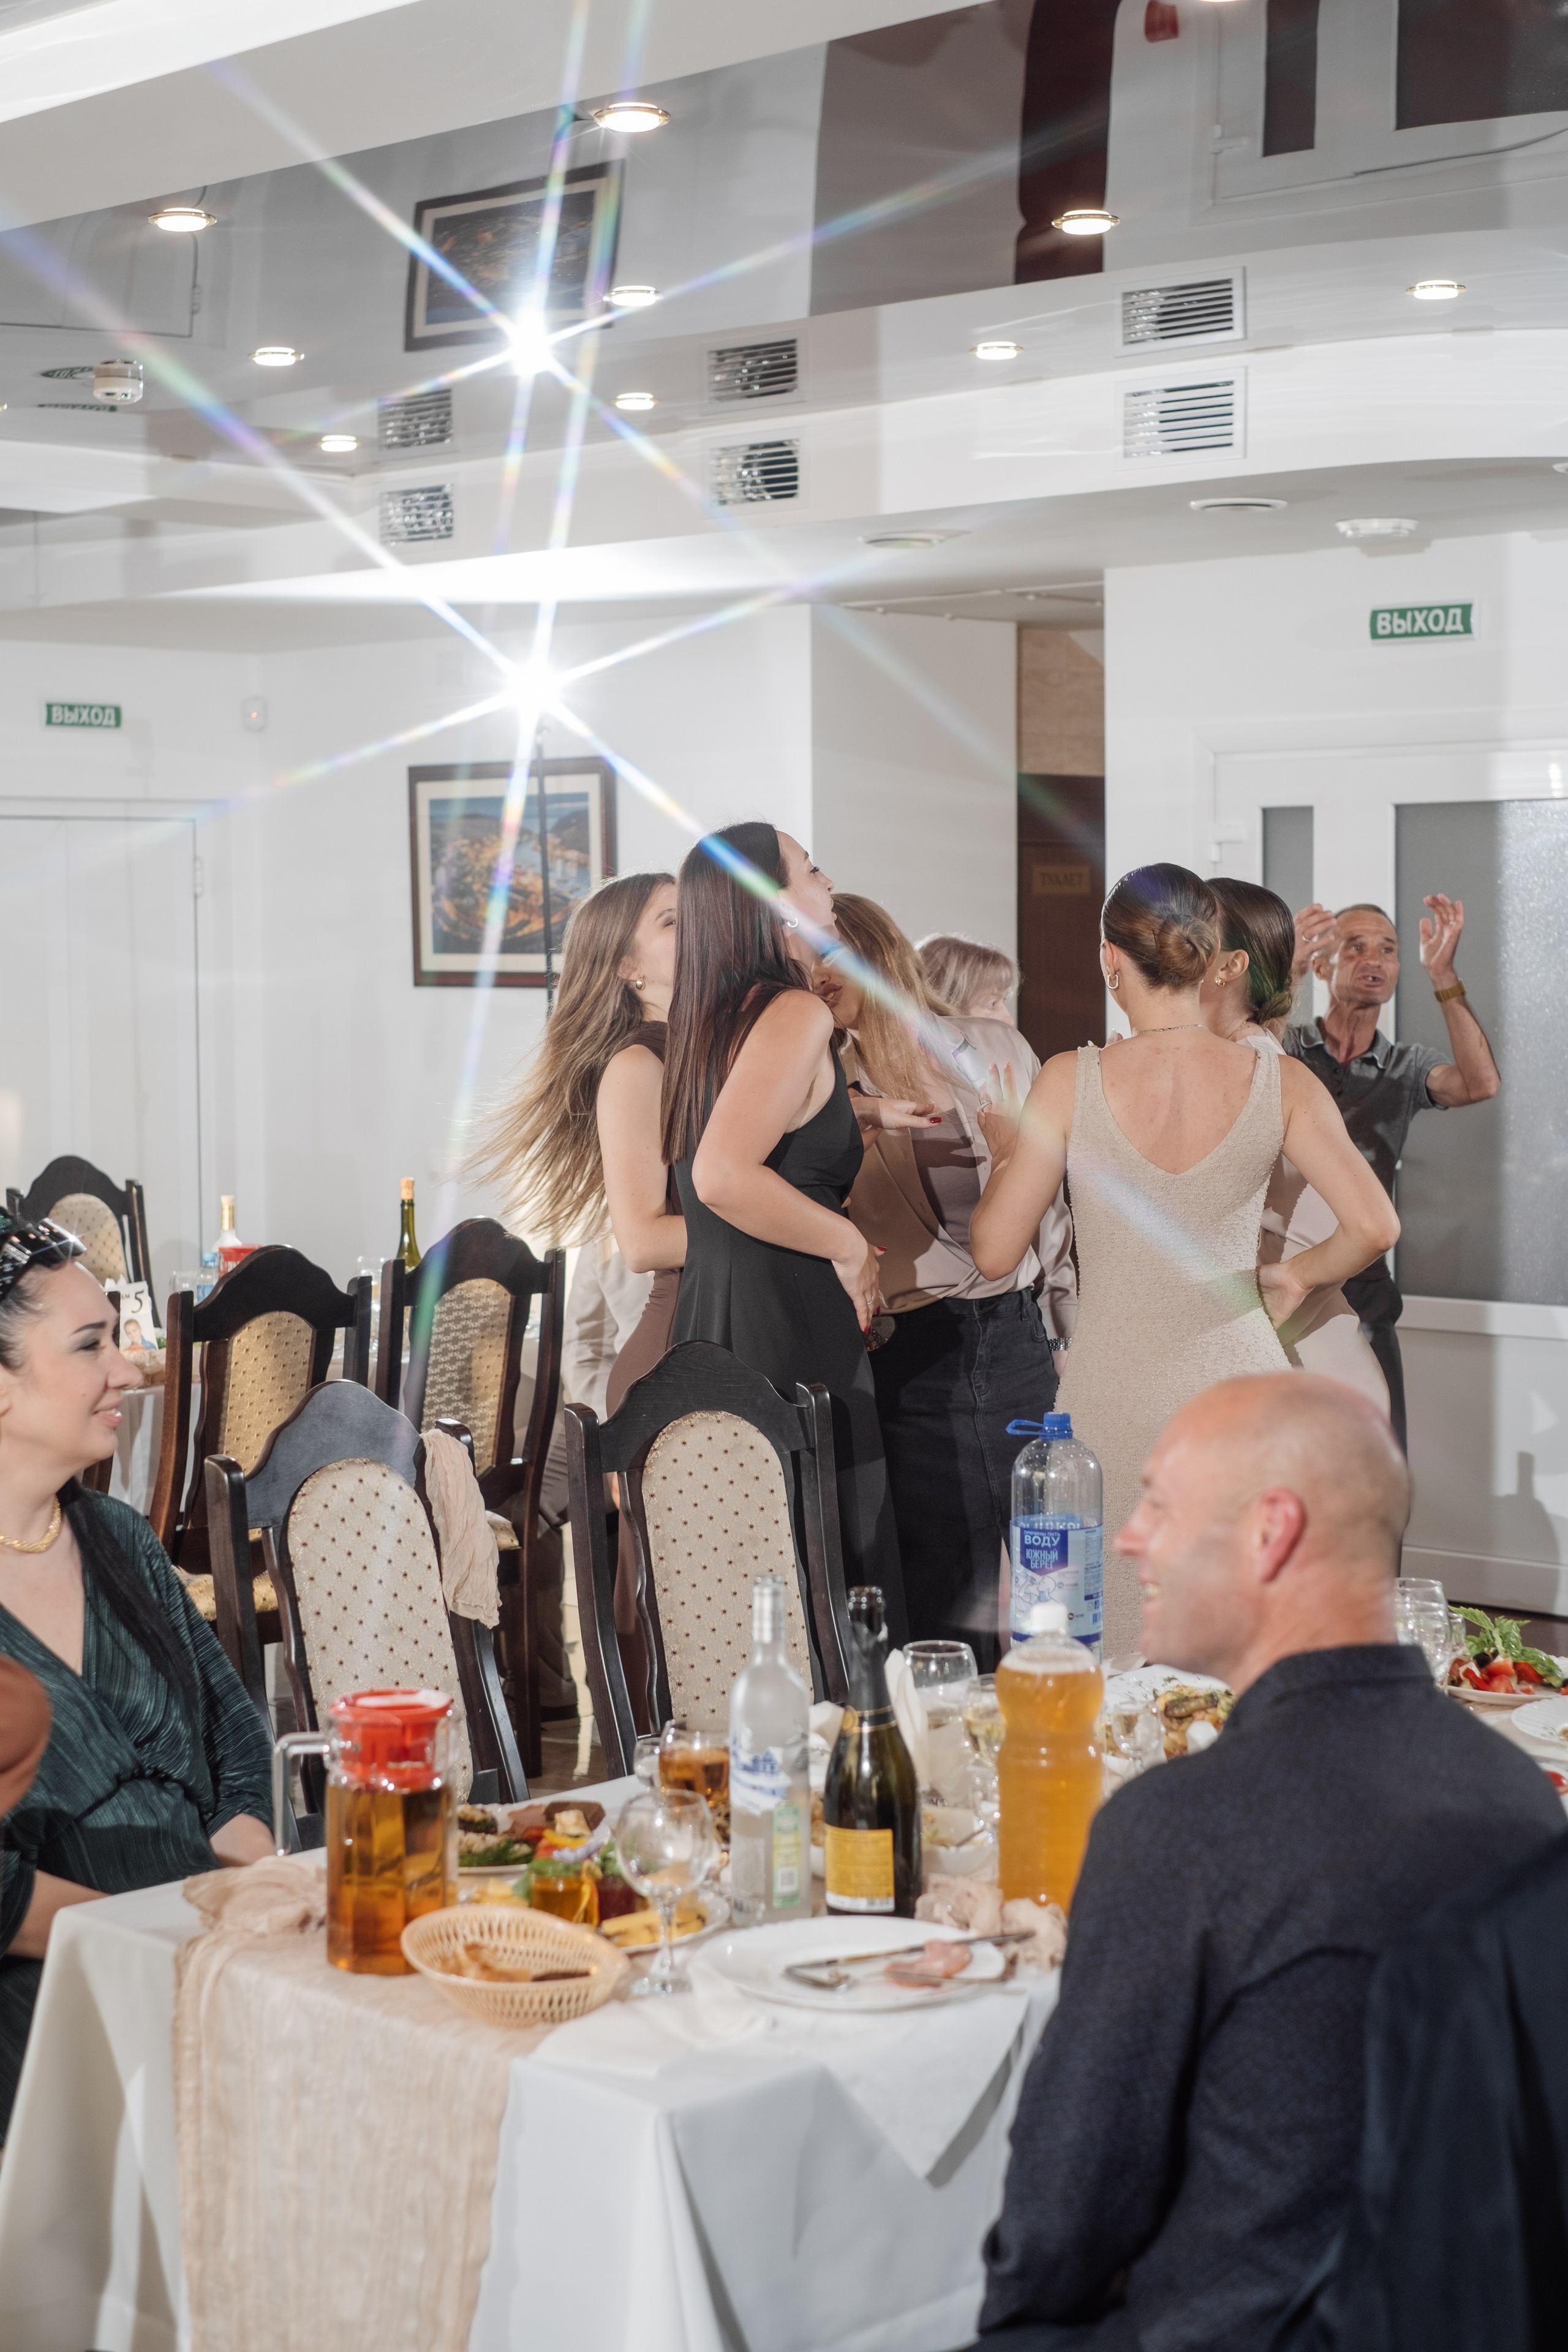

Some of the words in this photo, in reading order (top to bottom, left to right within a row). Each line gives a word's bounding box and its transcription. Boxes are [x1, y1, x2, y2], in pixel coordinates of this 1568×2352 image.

[1377, 607, 1464, 635] ВЫХОД
[51, 705, 116, 726] ВЫХОД
[132, 1289, 144, 1313] 5
[1025, 1534, 1060, 1547] ВОДУ
[1026, 1548, 1058, 1561] ЮЖНЫЙ
[1030, 1559, 1055, 1569] БЕРЕГ
